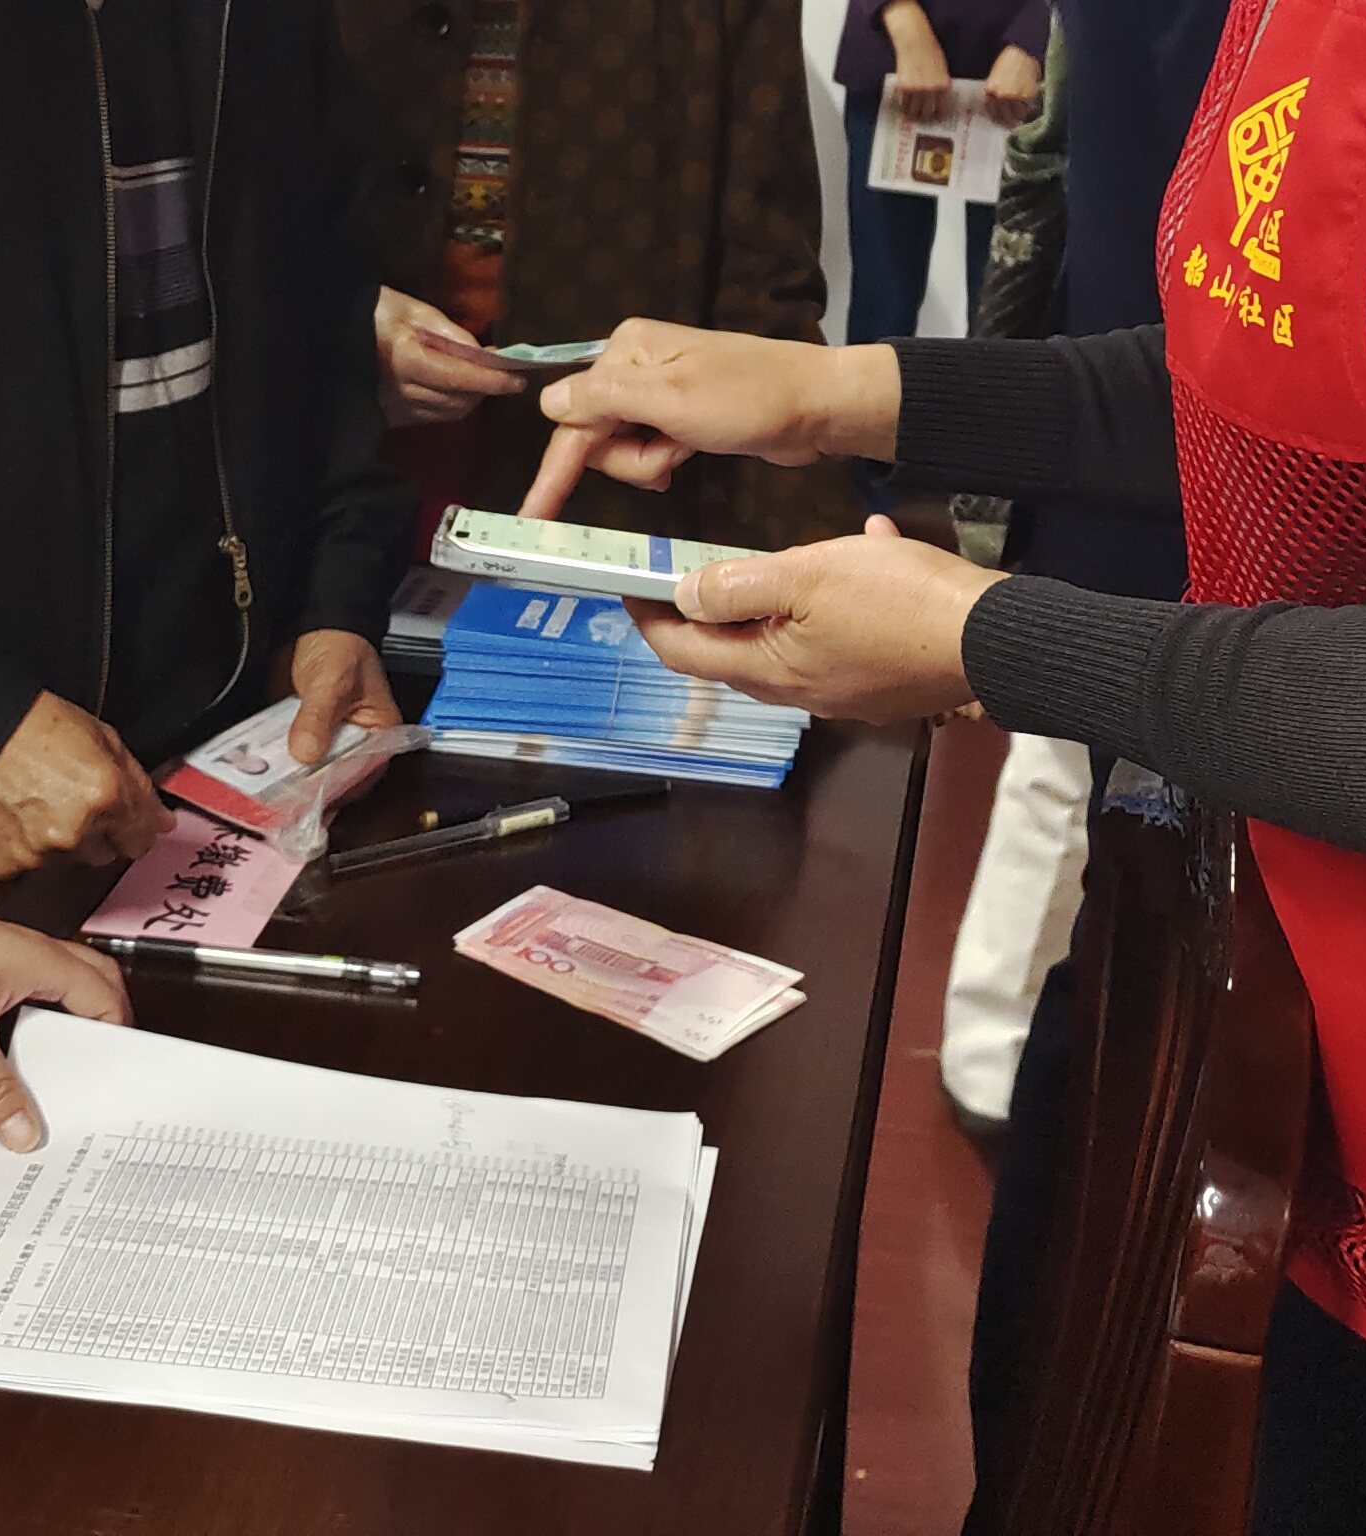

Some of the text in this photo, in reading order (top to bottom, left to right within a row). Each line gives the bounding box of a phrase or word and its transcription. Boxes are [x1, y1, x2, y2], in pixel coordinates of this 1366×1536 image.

[1183, 243, 1295, 348] 韶山社区
[513, 943, 576, 977] 100
